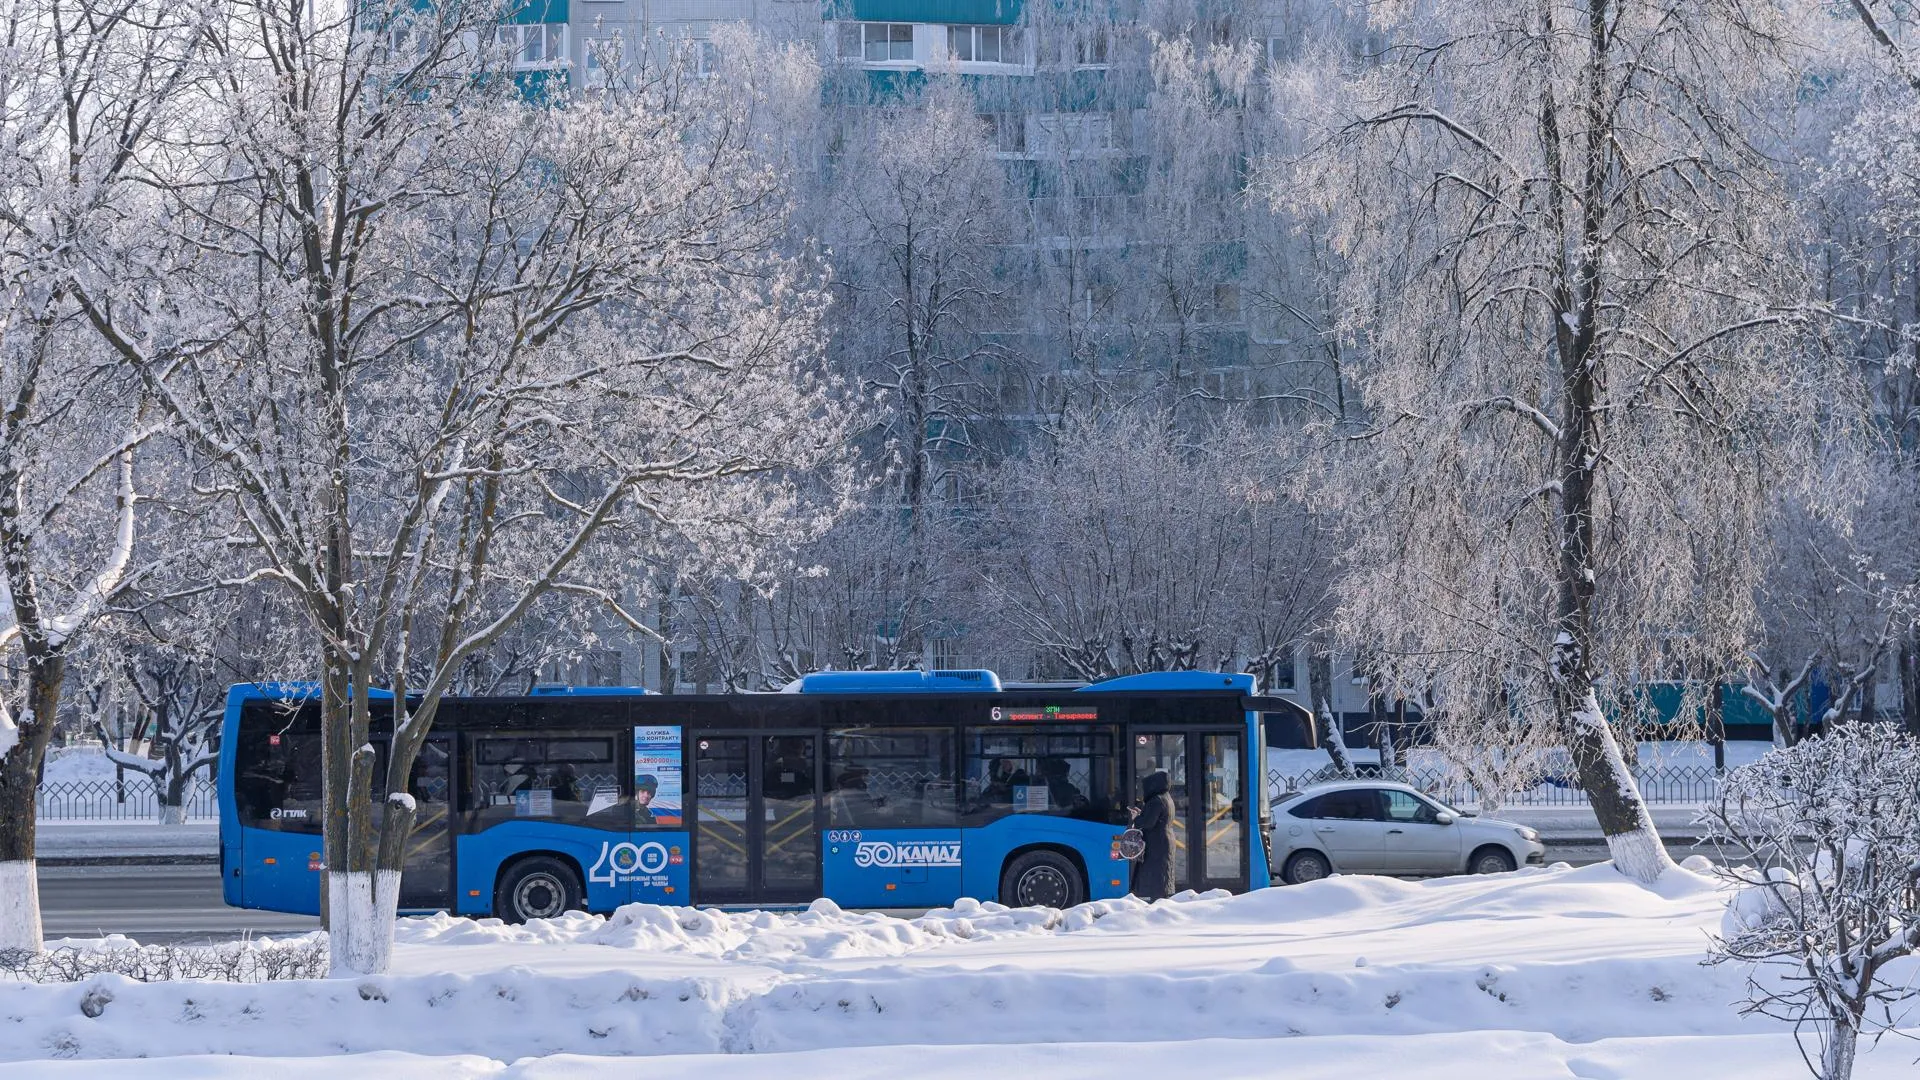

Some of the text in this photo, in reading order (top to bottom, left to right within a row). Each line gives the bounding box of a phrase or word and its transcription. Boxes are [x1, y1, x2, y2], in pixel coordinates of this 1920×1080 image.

[992, 707, 1001, 720] 6
[283, 809, 307, 818] ГТЛК
[855, 841, 961, 867] 50 KAMAZ
[589, 841, 668, 888] 400
